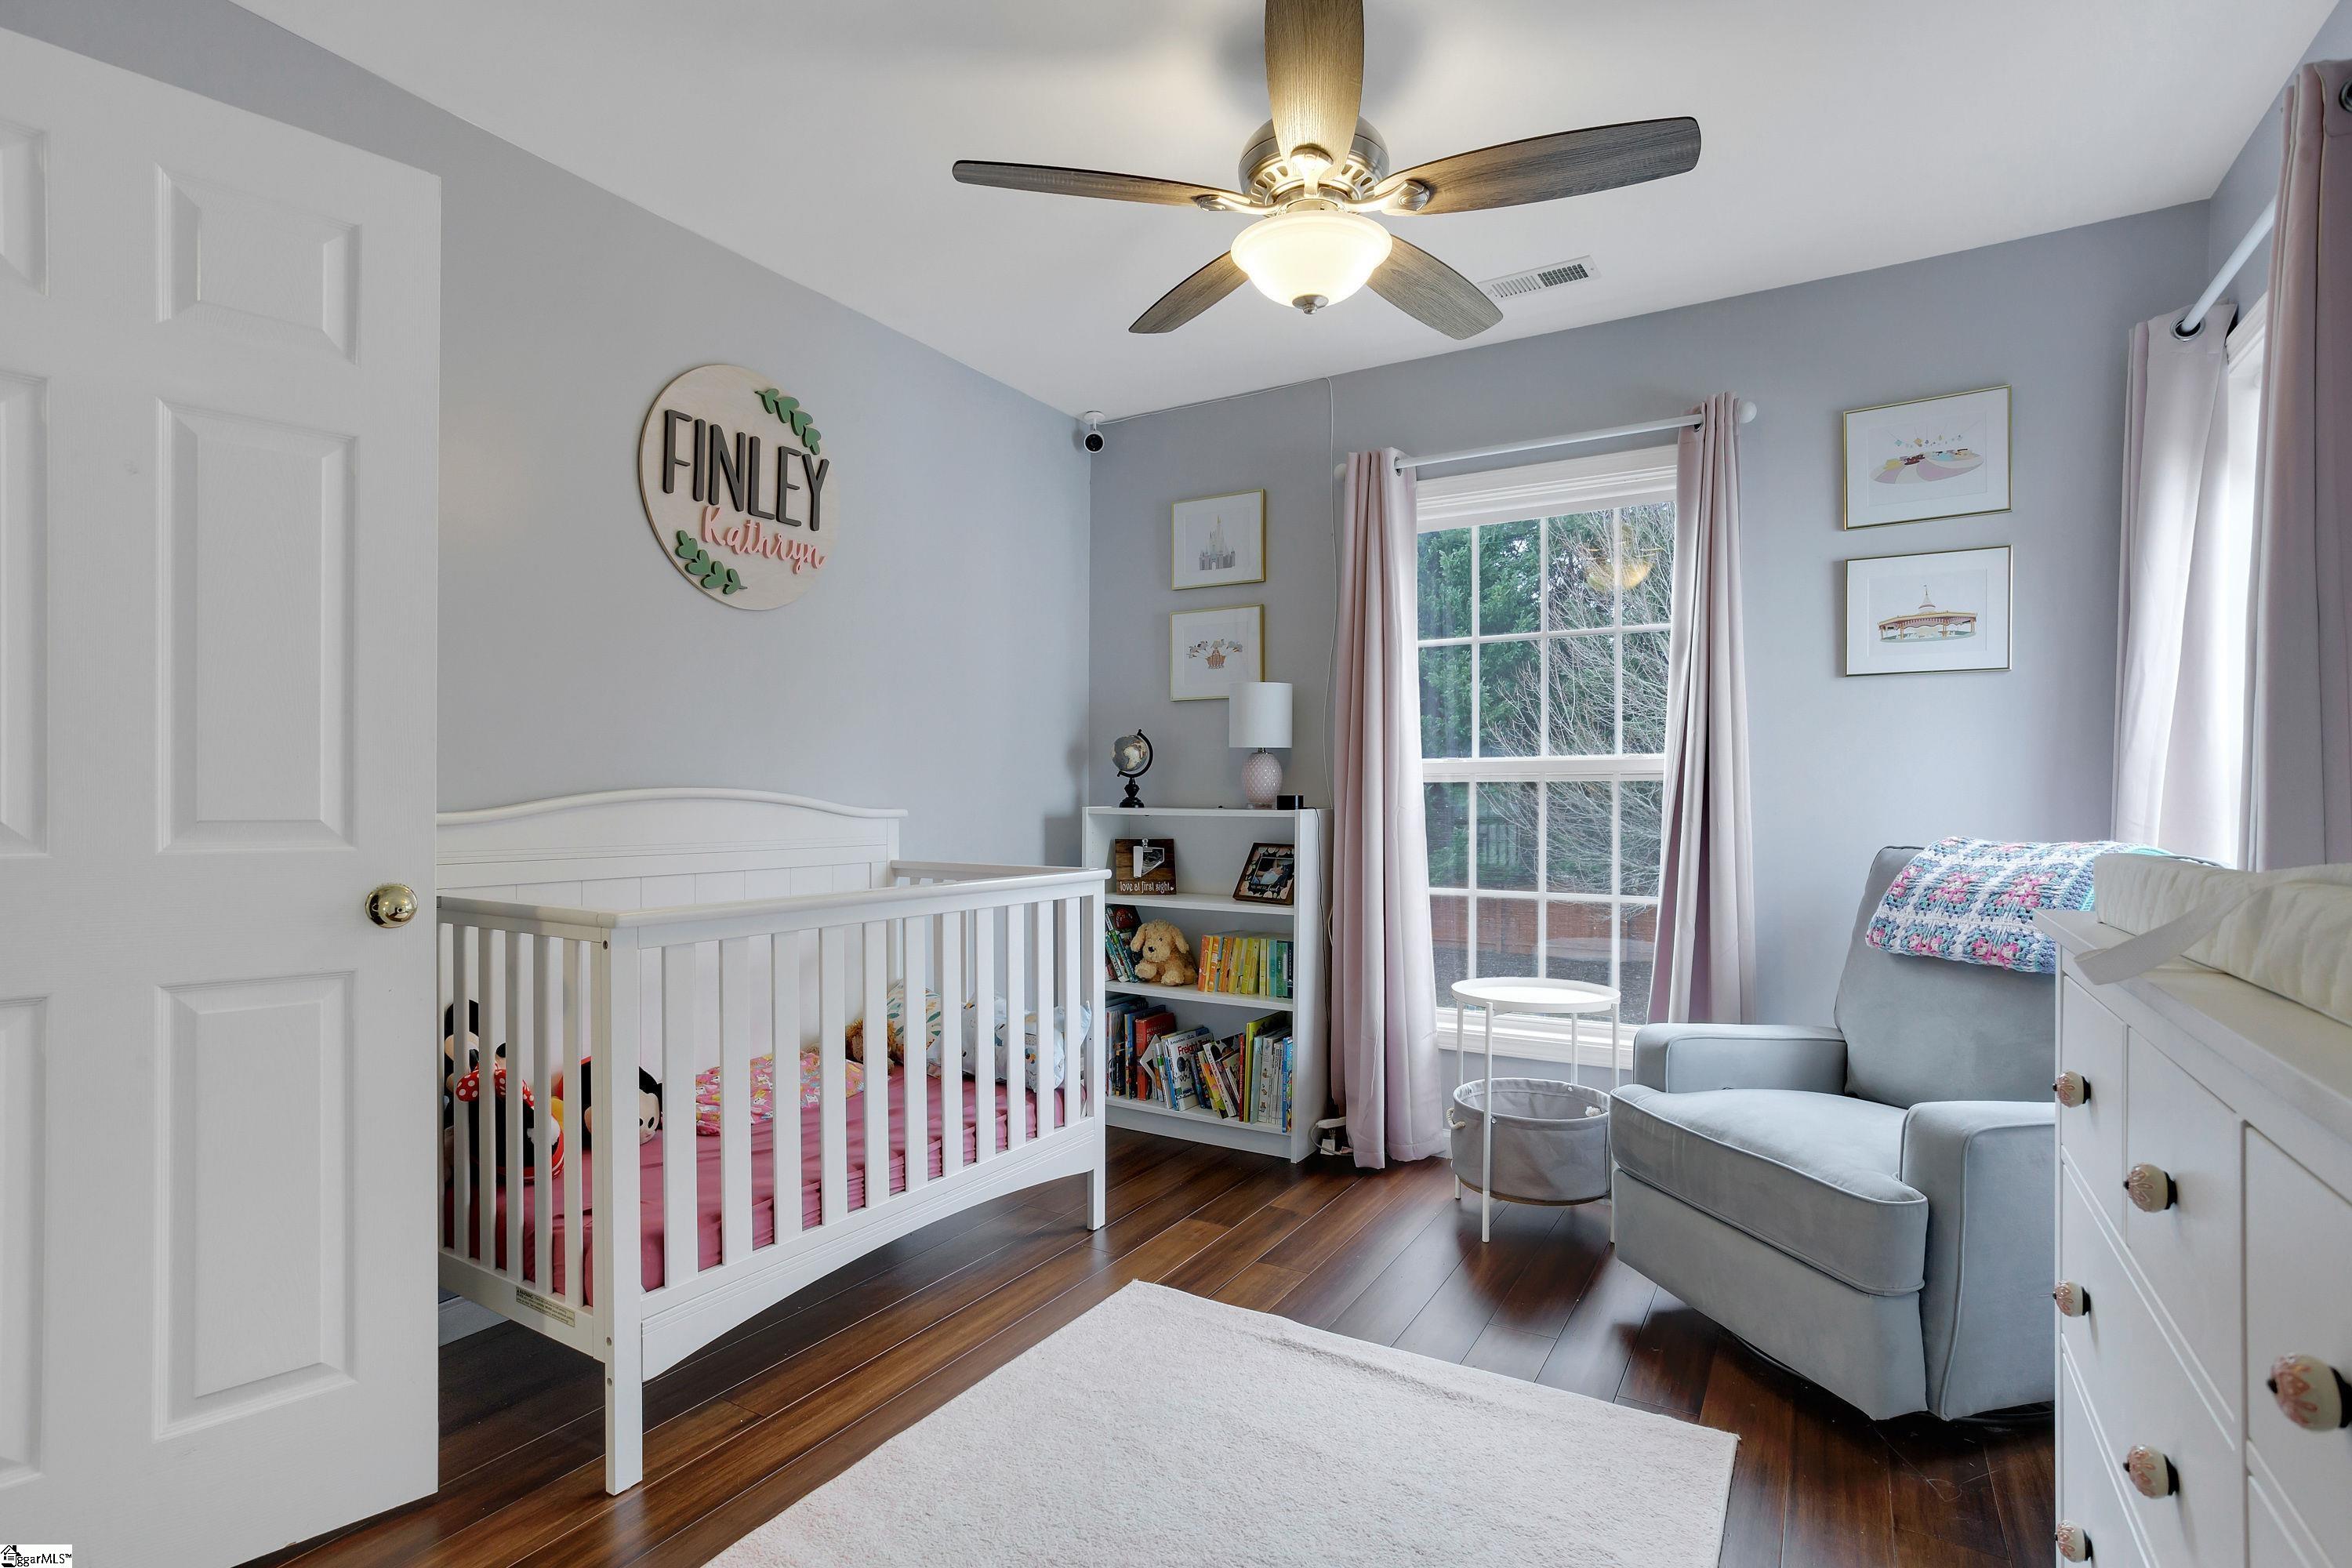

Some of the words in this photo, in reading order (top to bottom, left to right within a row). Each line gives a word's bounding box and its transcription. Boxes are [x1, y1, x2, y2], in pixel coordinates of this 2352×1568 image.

[662, 408, 830, 532] FINLEY
[701, 505, 826, 575] Kathryn
[1120, 880, 1134, 892] love
[1134, 881, 1141, 891] at
[1142, 880, 1155, 894] first
[1155, 880, 1171, 894] sight
[1178, 1042, 1198, 1056] Freight
